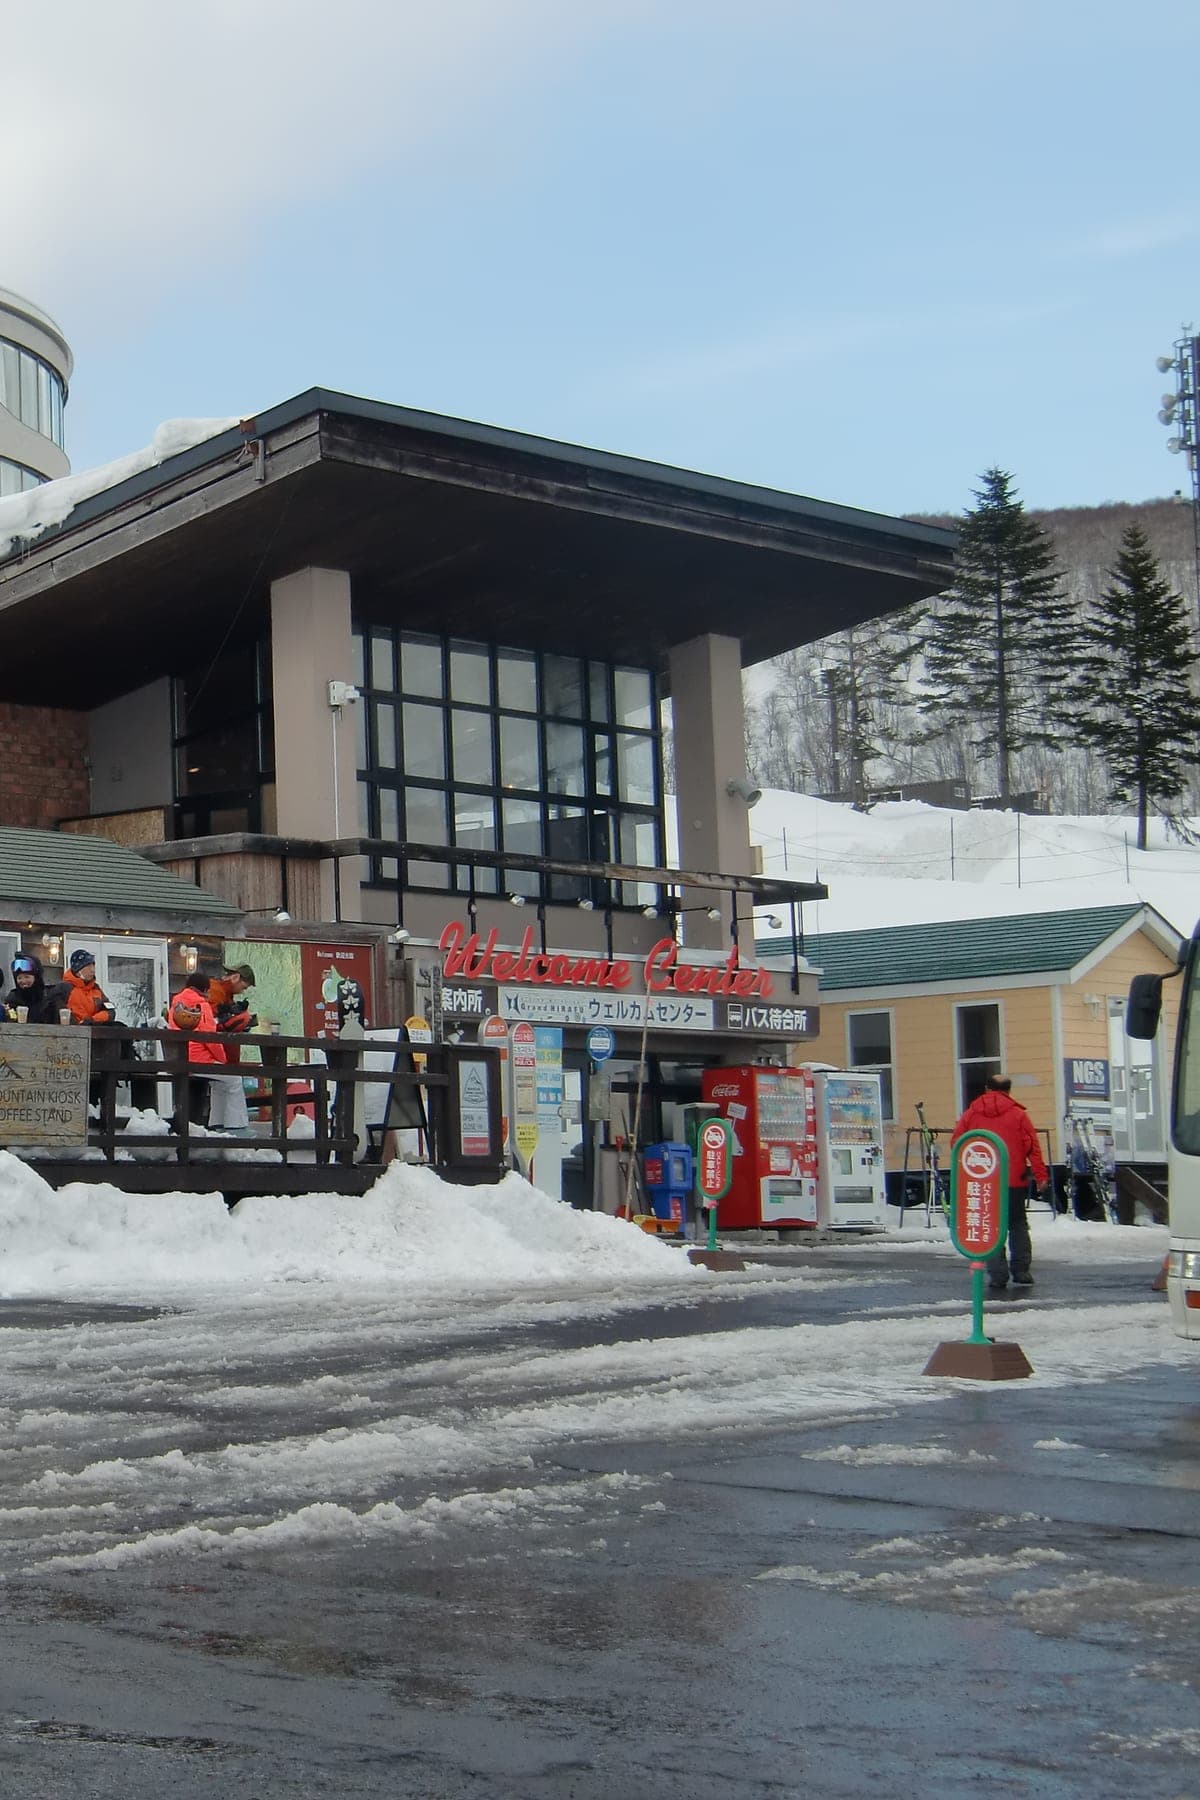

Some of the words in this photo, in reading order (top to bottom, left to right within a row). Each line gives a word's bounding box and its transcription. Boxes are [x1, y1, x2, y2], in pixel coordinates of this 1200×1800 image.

[438, 920, 632, 989] Welcome
[644, 937, 774, 998] Center
[520, 1002, 548, 1011] Grand
[744, 1006, 808, 1032] バス待合所
[46, 1052, 83, 1066] NISEKO
[43, 1067, 60, 1080] THE
[63, 1068, 85, 1080] DAY
[1072, 1060, 1105, 1085] NGS
[48, 1090, 81, 1104] KIOSK
[35, 1109, 73, 1123] STAND
[966, 1181, 981, 1242] 駐車禁止
